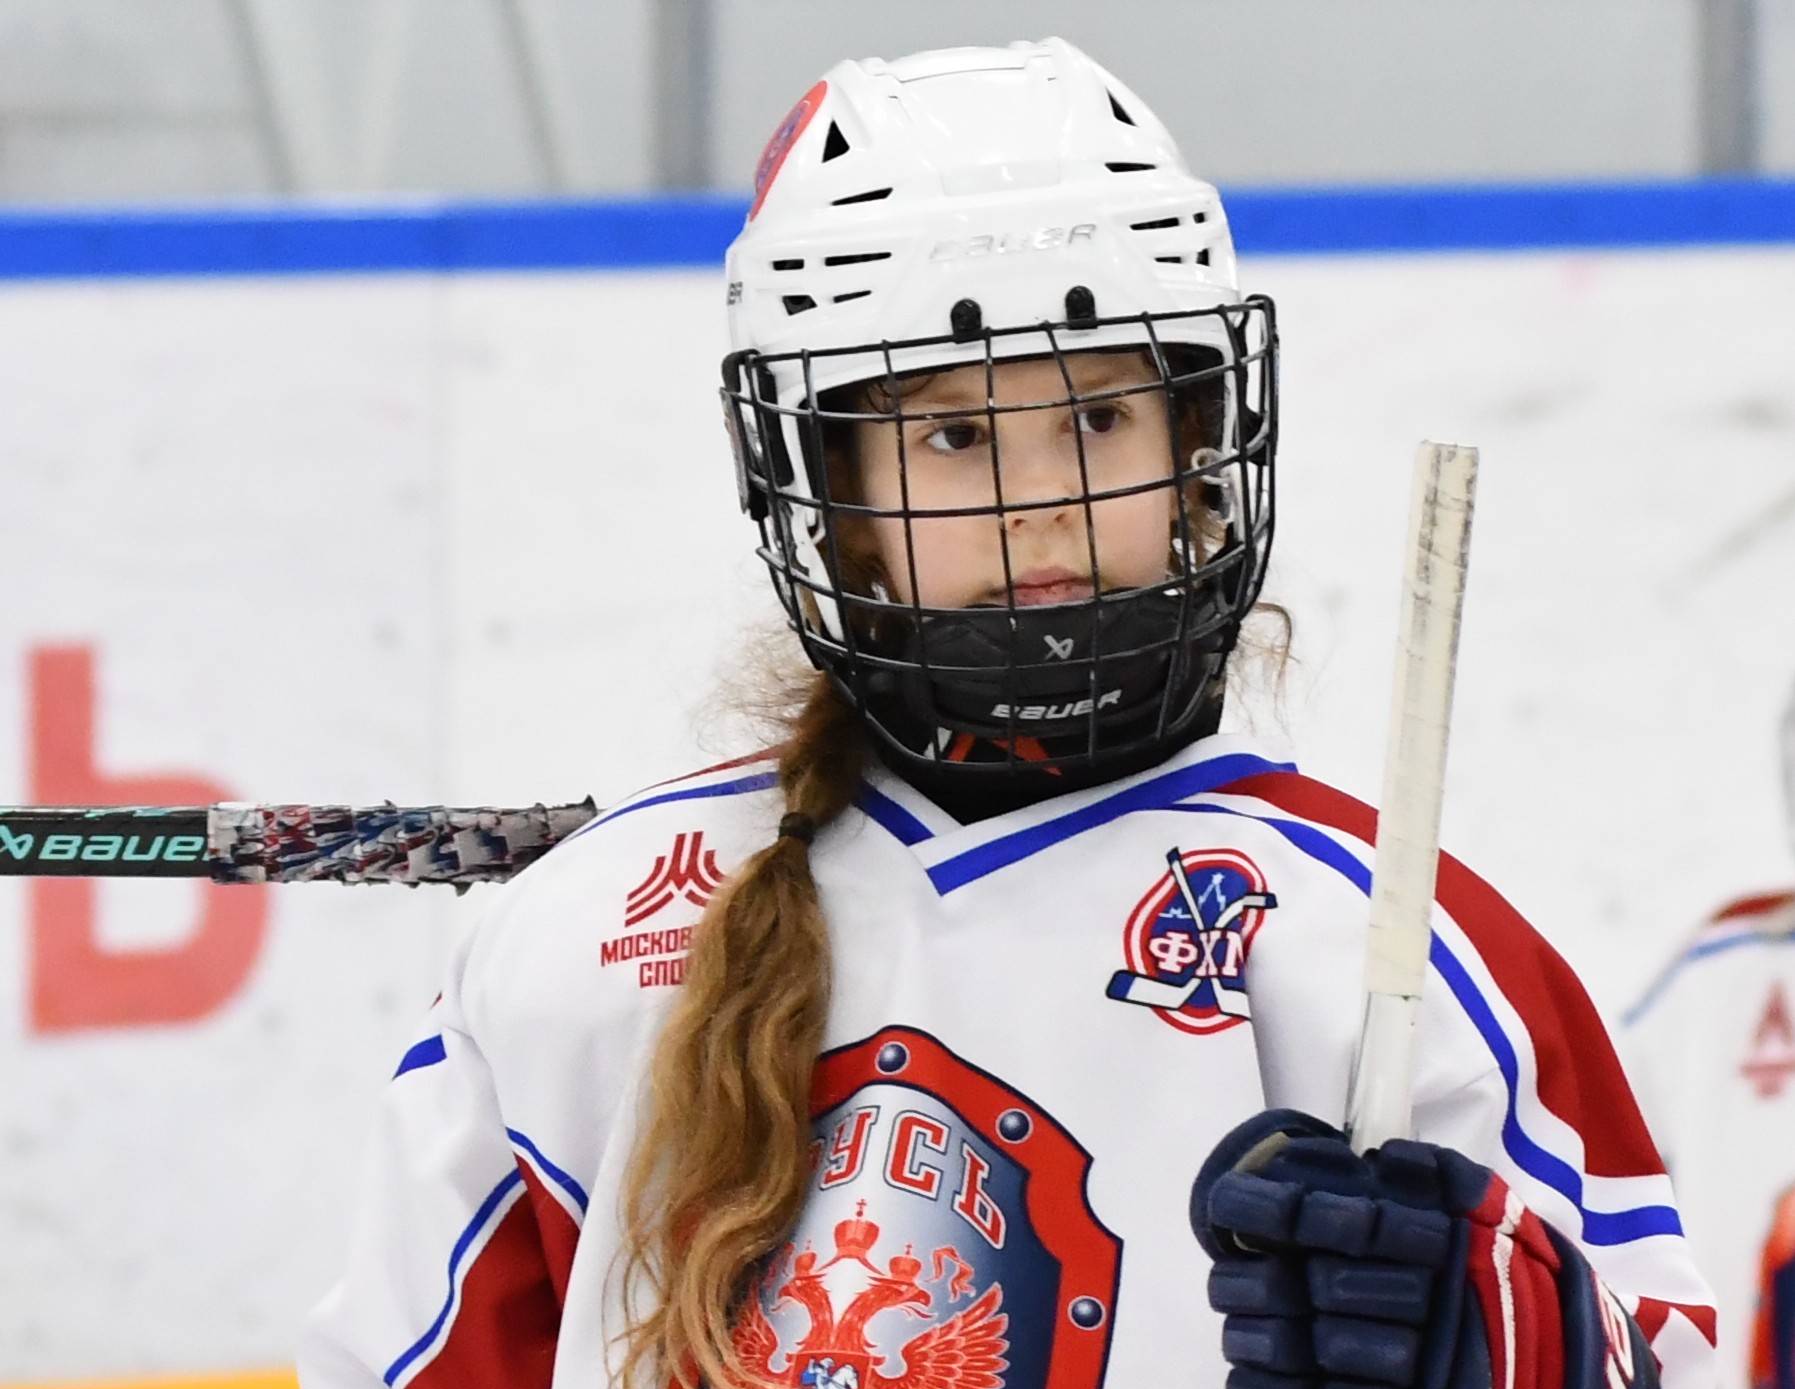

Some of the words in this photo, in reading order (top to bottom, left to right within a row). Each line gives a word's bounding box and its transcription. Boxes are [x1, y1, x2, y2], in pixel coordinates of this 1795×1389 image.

[990, 689, 1122, 720] BAUER
[38, 834, 212, 862] BAUE
[601, 924, 699, 967] МОСКОВ
[639, 957, 689, 989] СПО
[809, 1105, 1008, 1250] УСЬ
